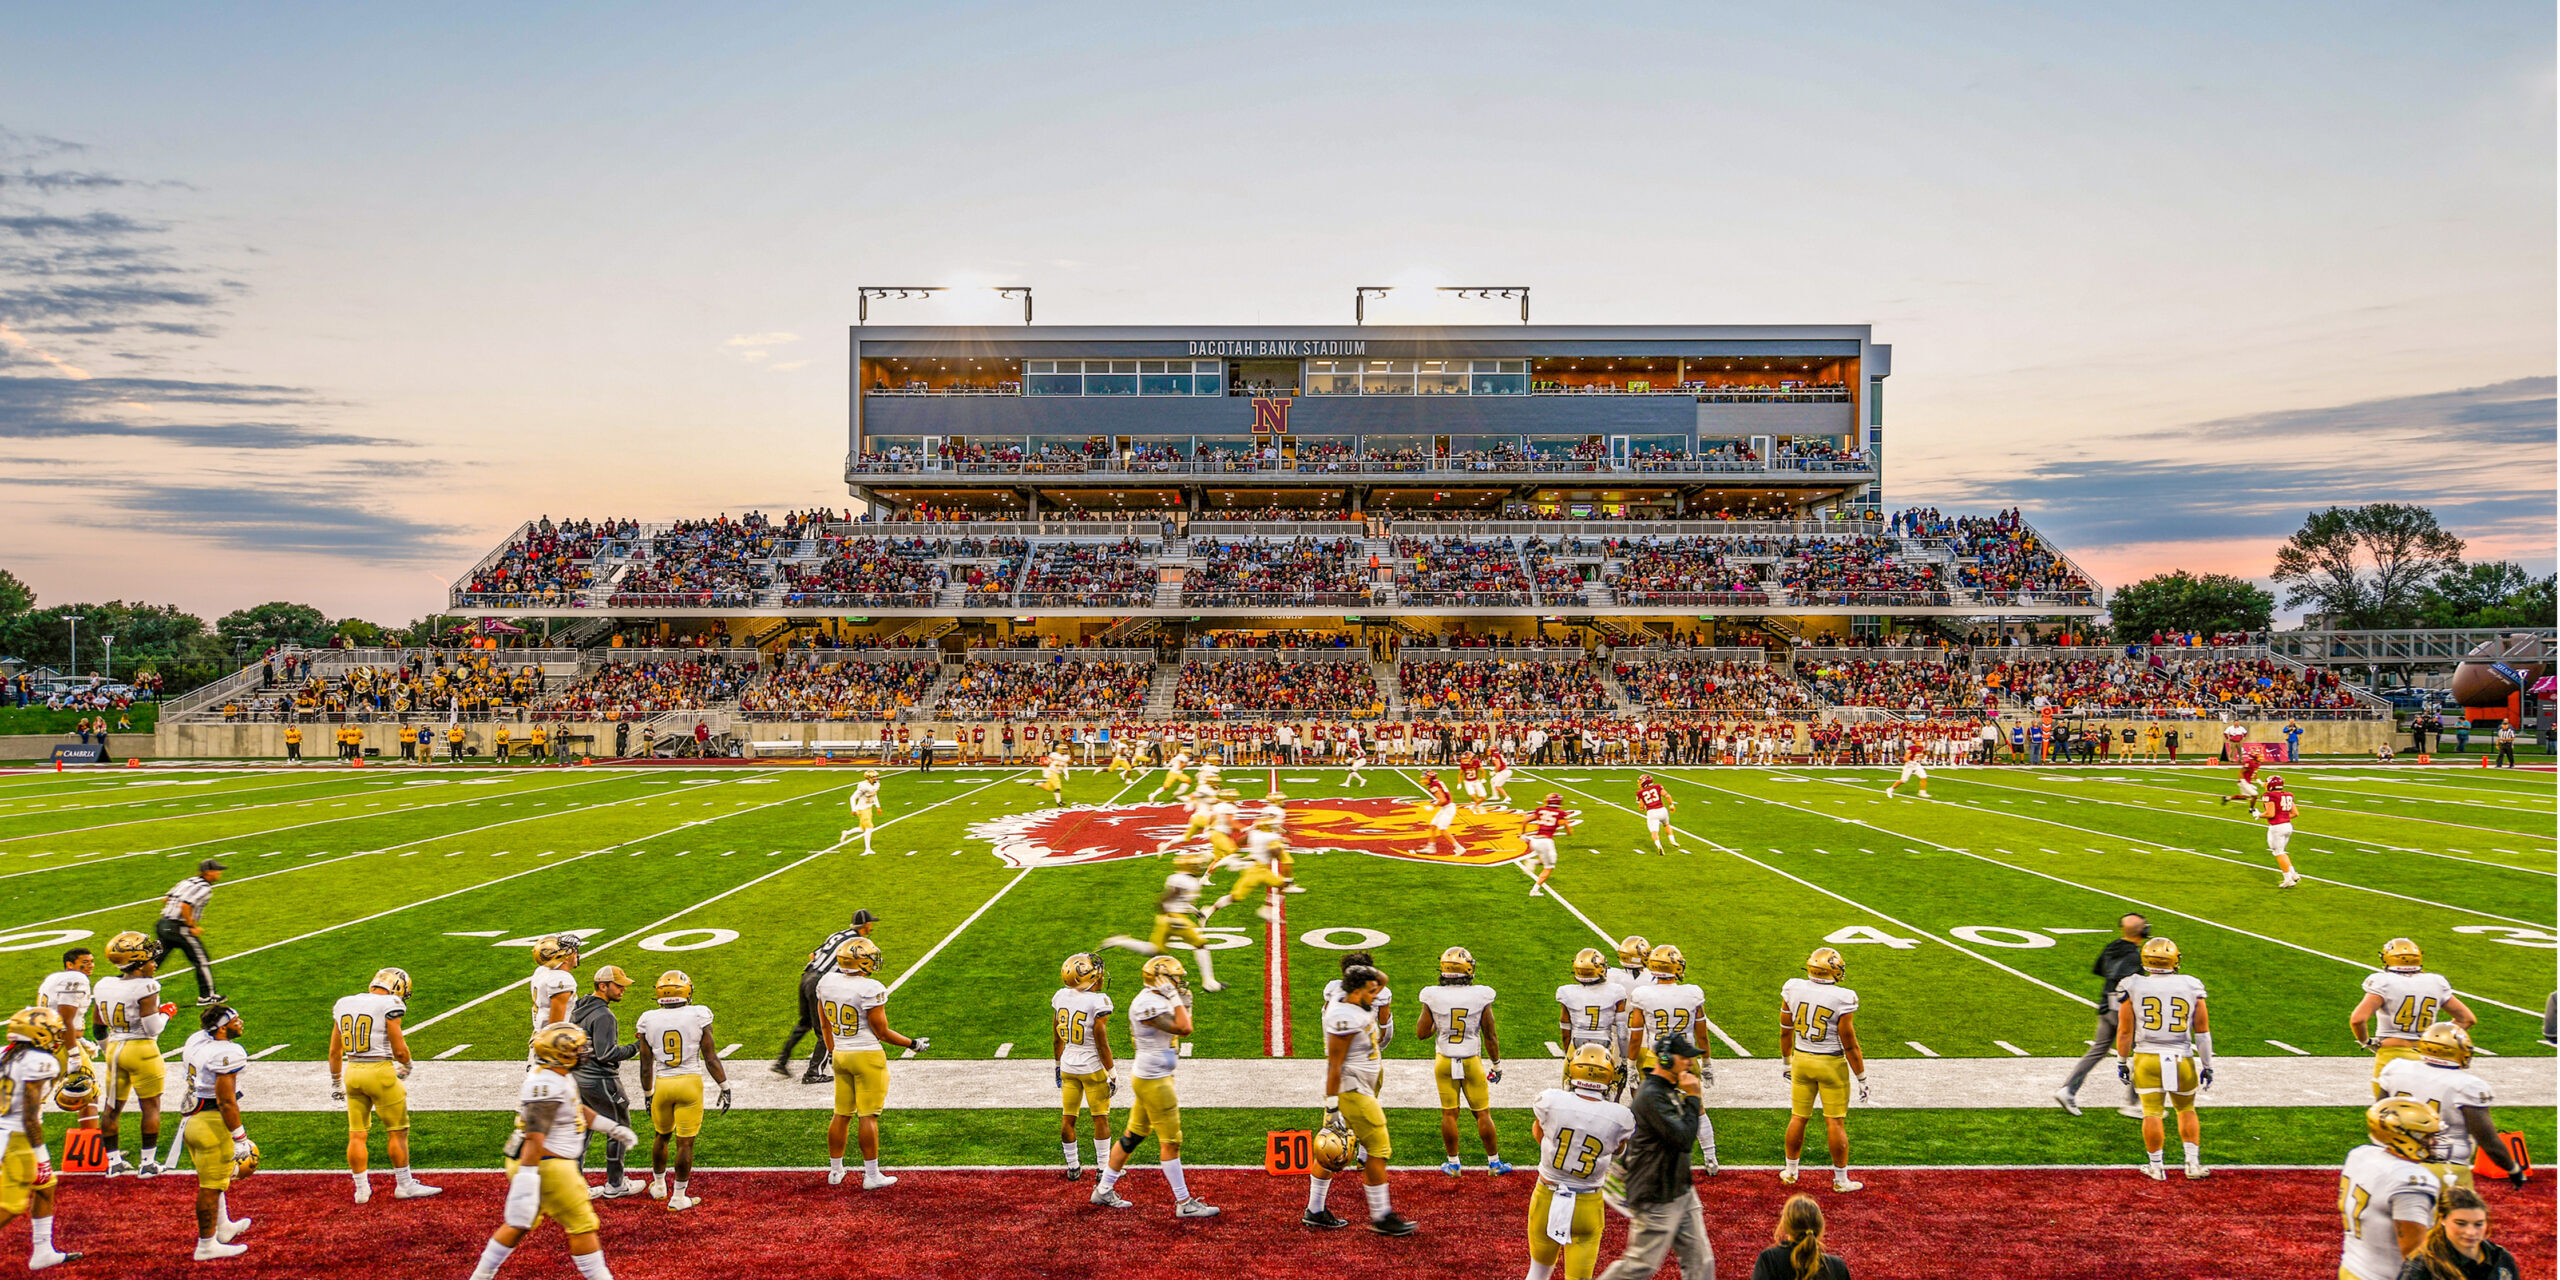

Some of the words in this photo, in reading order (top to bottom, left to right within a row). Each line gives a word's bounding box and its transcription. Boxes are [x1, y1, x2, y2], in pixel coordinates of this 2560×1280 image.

[1189, 341, 1252, 356] DACOTAH
[1259, 341, 1297, 356] BANK
[1303, 341, 1366, 356] STADIUM
[1251, 397, 1292, 434] N
[63, 750, 95, 758] CAMBRIA
[1465, 770, 1477, 779] 21
[1642, 788, 1660, 804] 23
[2280, 795, 2294, 811] 48
[101, 1001, 130, 1033] 14
[824, 1000, 859, 1037] 99
[1056, 1008, 1088, 1045] 86
[1448, 1007, 1469, 1044] 5
[1585, 1006, 1600, 1031] 7
[1653, 1008, 1690, 1040] 32
[1794, 1002, 1835, 1042] 45
[2142, 996, 2190, 1032] 33
[2393, 995, 2438, 1032] 46
[340, 1014, 373, 1054] 80
[662, 1029, 682, 1068] 9
[66, 1134, 104, 1168] 40
[1274, 1135, 1309, 1169] 50
[1553, 1127, 1604, 1179] 13
